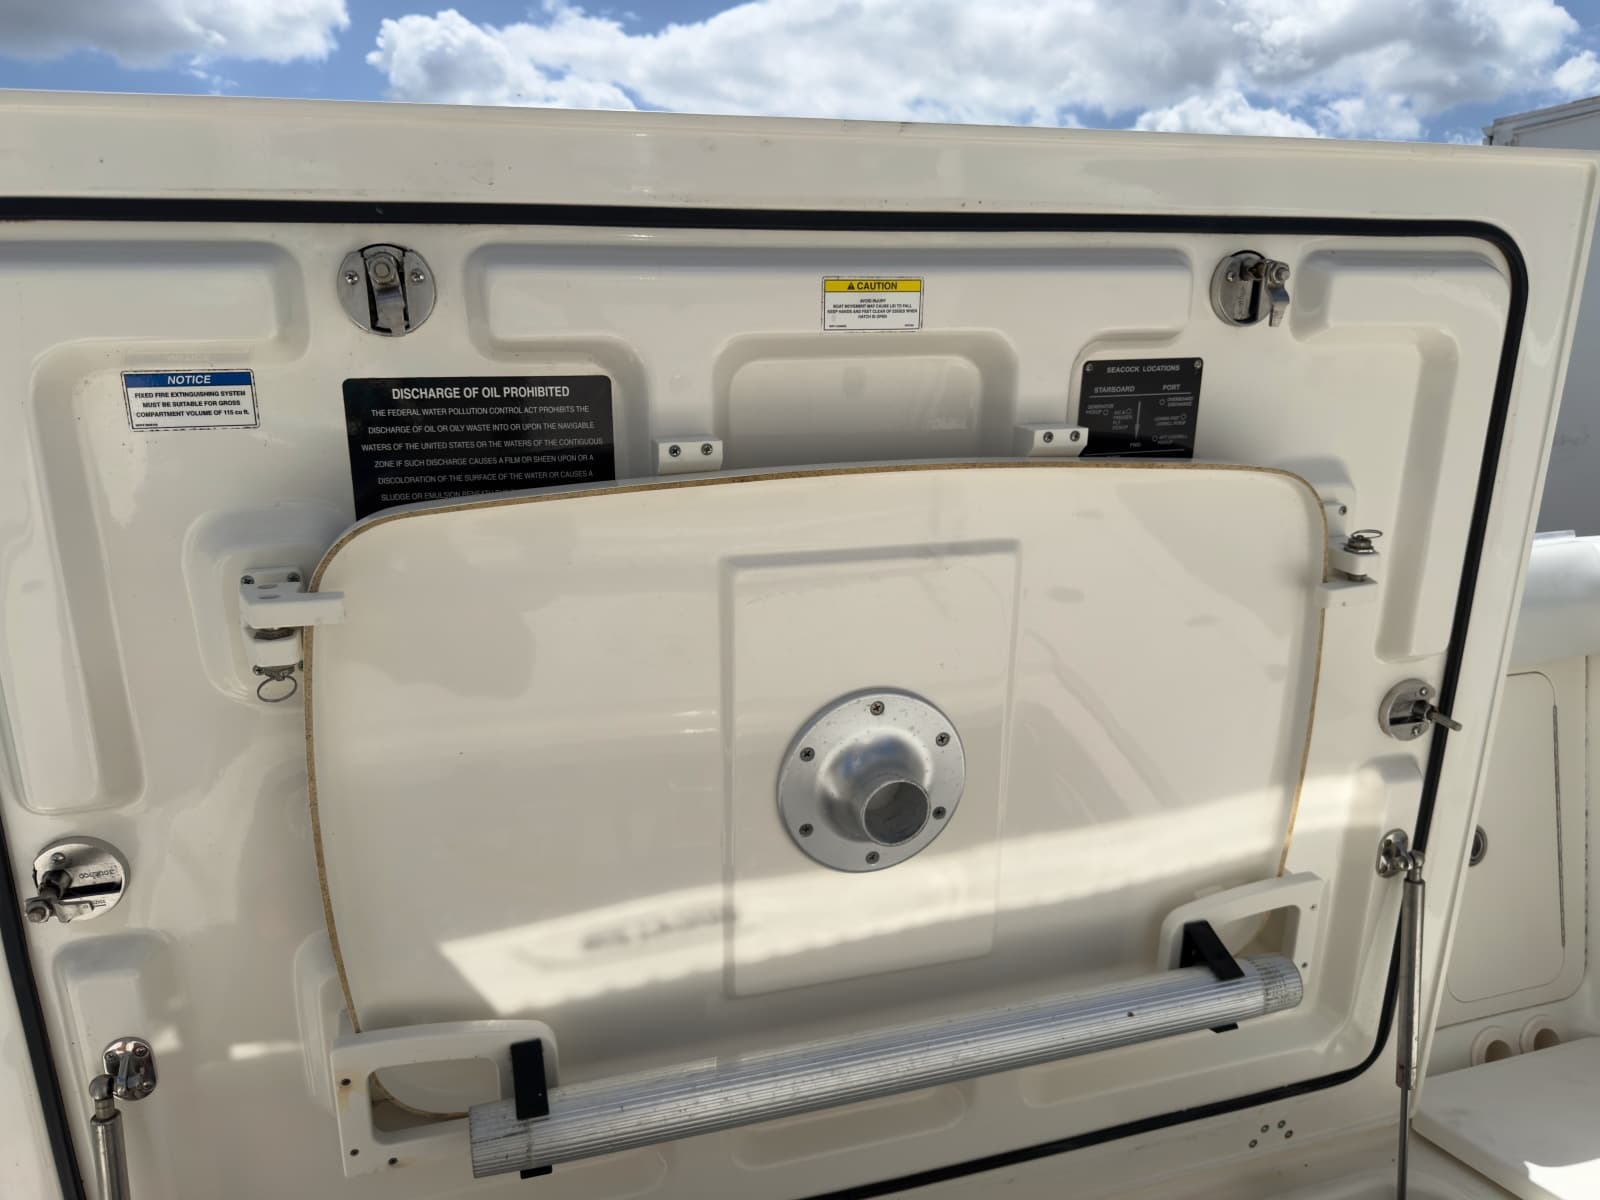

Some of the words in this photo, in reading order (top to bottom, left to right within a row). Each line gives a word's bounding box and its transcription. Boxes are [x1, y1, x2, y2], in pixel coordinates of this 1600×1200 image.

[857, 282, 898, 290] CAUTION
[167, 375, 211, 385] NOTICE
[392, 388, 461, 399] DISCHARGE
[463, 387, 479, 398] OF
[481, 387, 501, 398] OIL
[503, 386, 570, 397] PROHIBITED
[371, 409, 386, 417] THE
[421, 408, 447, 416] WATER
[368, 426, 410, 434] DISCHARGE
[449, 424, 465, 432] OILY
[492, 423, 509, 431] INTO
[361, 443, 392, 451] WATERS
[406, 442, 420, 450] THE
[476, 440, 487, 448] OR
[489, 440, 502, 448] THE
[533, 439, 544, 447] OF
[559, 438, 603, 446] CONTIGUOUS
[374, 460, 395, 468] ZONE
[404, 459, 425, 467] SUCH
[426, 458, 467, 466] DISCHARGE
[468, 457, 497, 465] CAUSES
[505, 456, 521, 464] FILM
[533, 455, 556, 463] SHEEN
[378, 476, 436, 485] DISCOLORATION
[438, 475, 448, 483] OF
[465, 473, 496, 482] SURFACE
[510, 472, 523, 480] THE
[549, 471, 559, 479] OR
[560, 470, 587, 478] CAUSES
[381, 493, 410, 501] SLUDGE
[411, 492, 423, 500] OR
